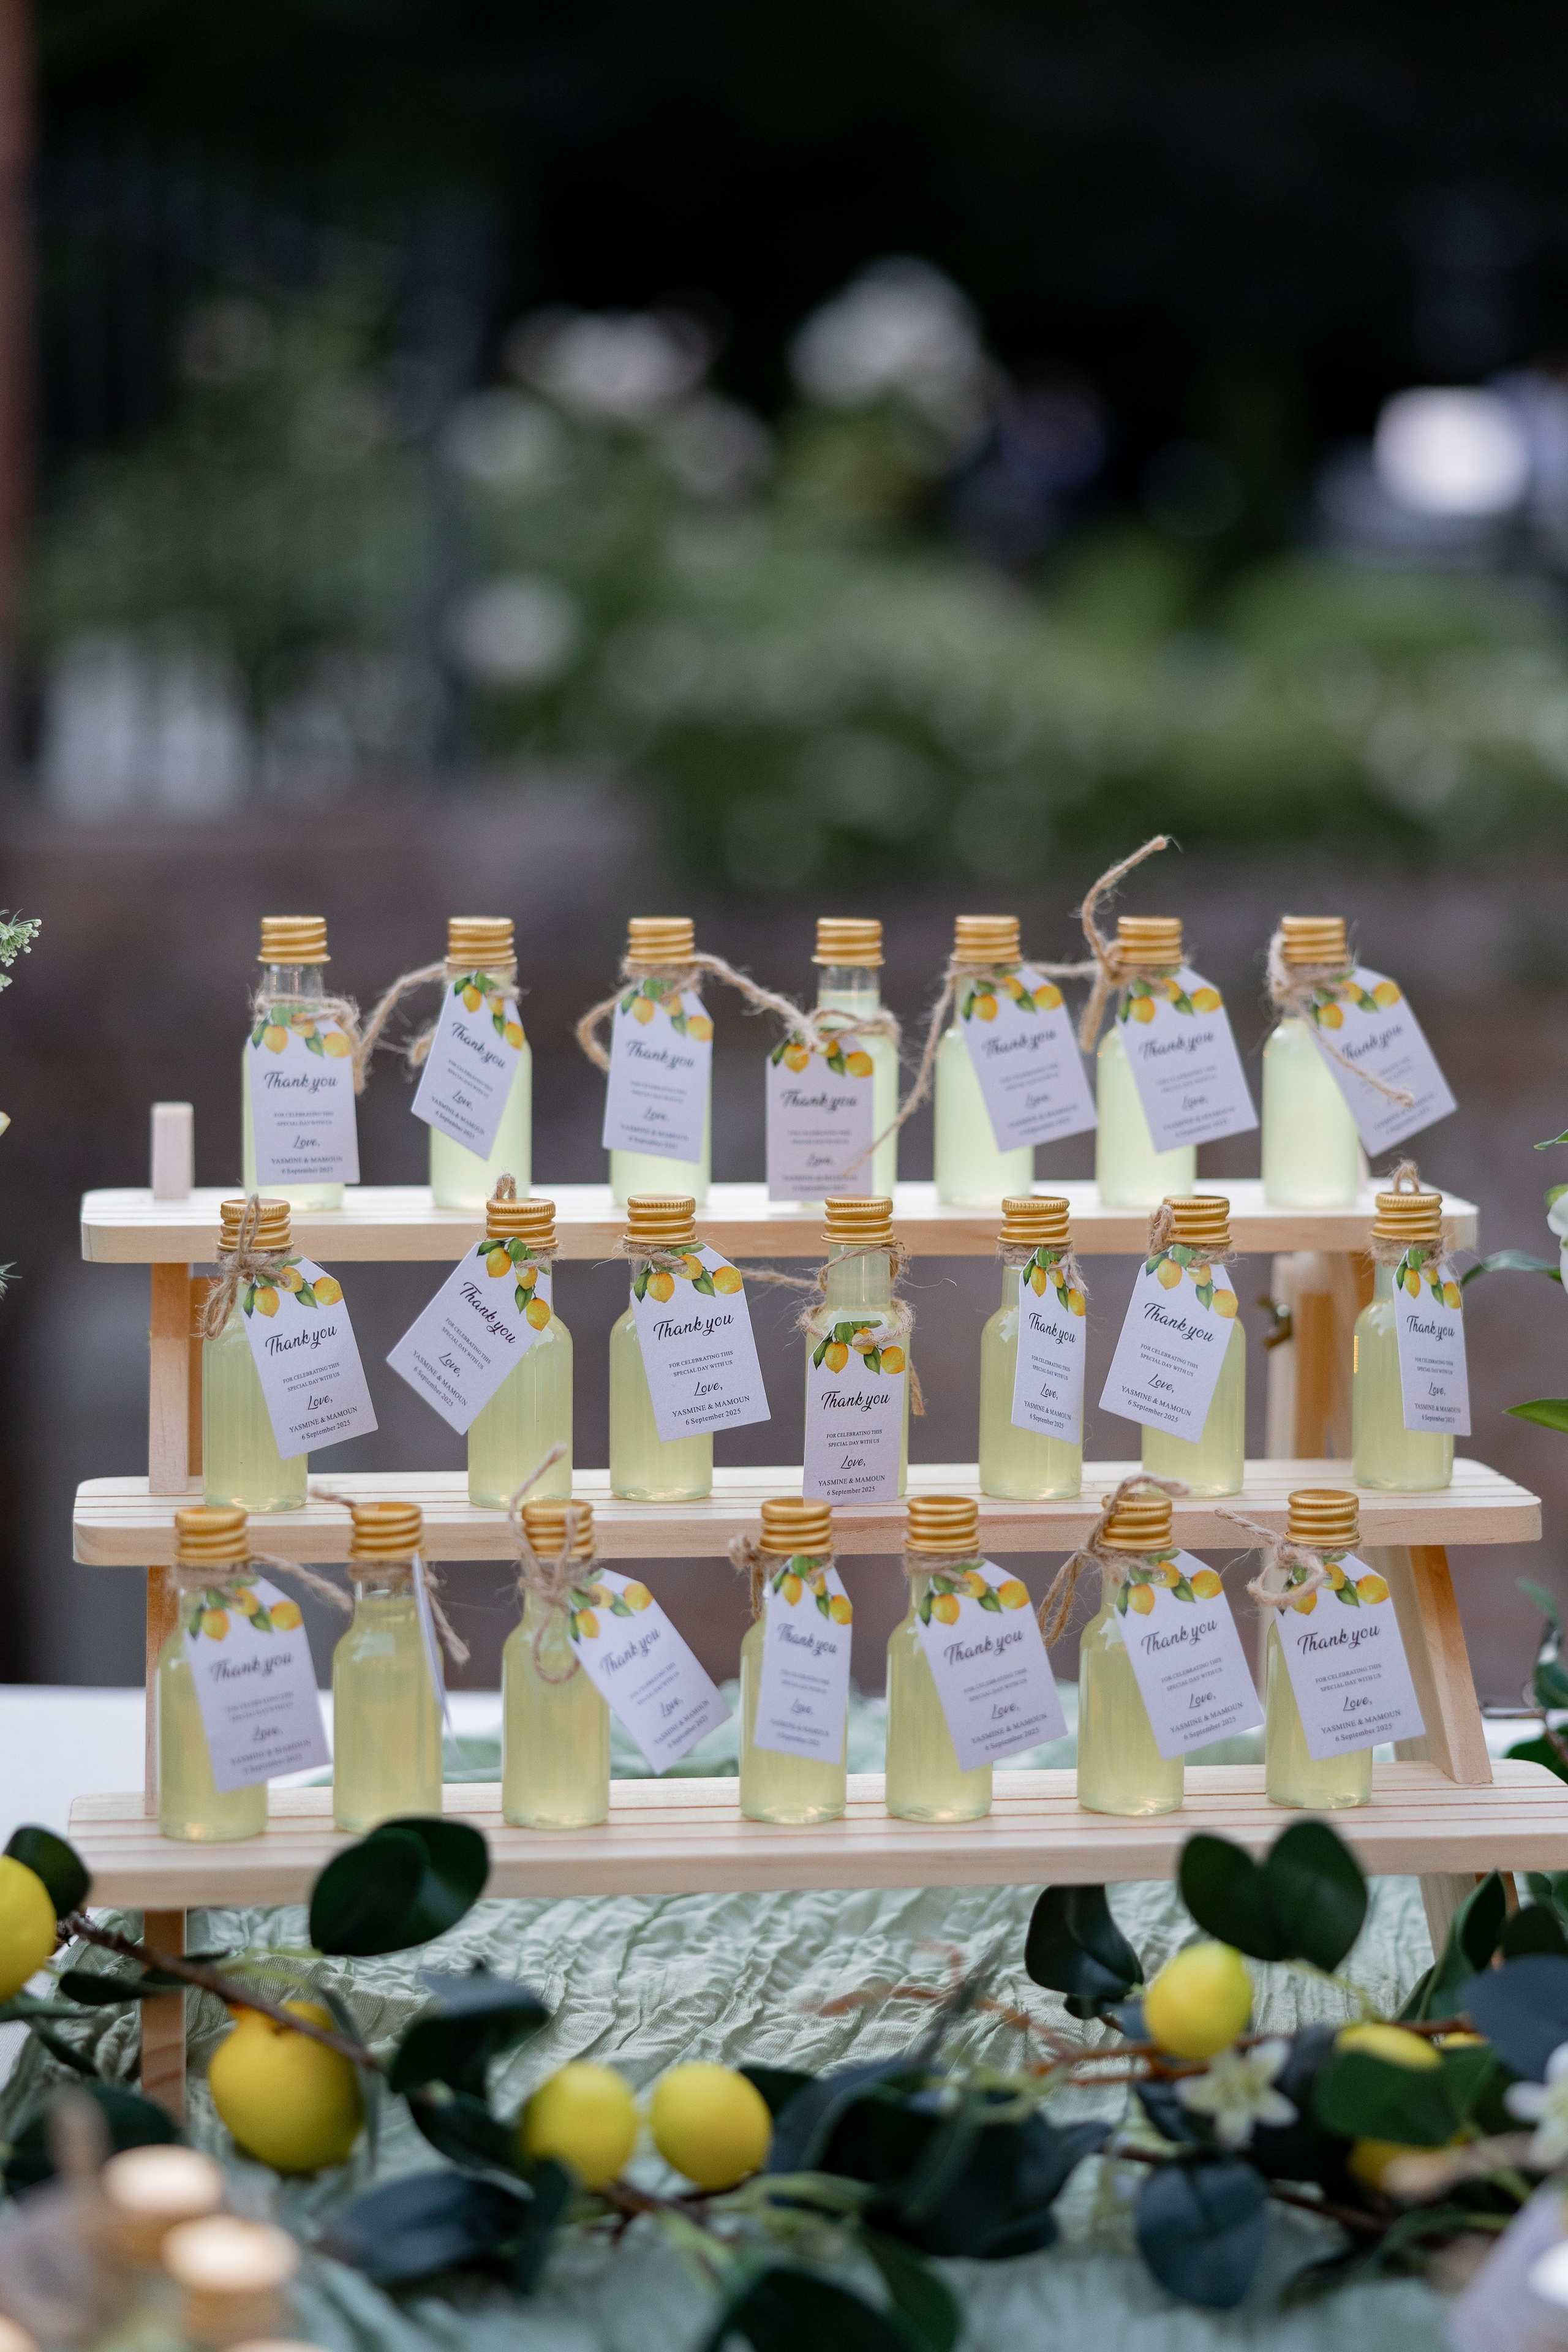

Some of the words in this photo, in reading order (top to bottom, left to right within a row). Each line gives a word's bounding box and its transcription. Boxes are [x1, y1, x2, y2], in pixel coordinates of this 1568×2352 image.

[451, 1021, 486, 1055] Thank
[480, 1050, 506, 1069] you
[625, 1039, 670, 1063] Thank
[665, 1054, 697, 1071] you
[263, 1071, 311, 1090] Thank
[307, 1077, 339, 1094] you
[459, 1281, 497, 1322] Thank
[486, 1321, 515, 1343] you
[1144, 1302, 1188, 1332] Thank
[1181, 1325, 1214, 1342] you
[652, 1315, 704, 1341] Thank
[701, 1314, 734, 1336] you
[1028, 1312, 1058, 1336] Thank
[1055, 1329, 1076, 1344] you
[1406, 1314, 1437, 1335] Thank
[1434, 1325, 1455, 1341] you
[265, 1329, 311, 1356] Thank
[309, 1325, 337, 1349] you
[441, 1326, 458, 1344] SPECIAL
[458, 1343, 468, 1353] DAY
[467, 1351, 478, 1364] WITH
[445, 1317, 454, 1328] FOR
[453, 1326, 481, 1355] CELEBRATING
[480, 1352, 491, 1364] THIS
[438, 1352, 461, 1378] Love,
[680, 1352, 720, 1365] CELEBRATING
[1038, 1357, 1061, 1369] CELEBRATING
[1140, 1343, 1151, 1351] FOR
[1151, 1348, 1186, 1364] CELEBRATING
[1186, 1360, 1198, 1369] THIS
[1140, 1352, 1160, 1364] SPECIAL
[1173, 1365, 1186, 1374] WITH
[293, 1365, 328, 1380] CELEBRATING
[412, 1349, 438, 1376] YASMINE
[440, 1378, 468, 1406] MAMOUN
[673, 1367, 695, 1377] SPECIAL
[1031, 1364, 1046, 1373] SPECIAL
[287, 1381, 307, 1392] SPECIAL
[417, 1369, 442, 1395] September
[440, 1393, 454, 1406] 2025
[693, 1381, 723, 1396] Love,
[1039, 1382, 1058, 1400] Love,
[1147, 1373, 1174, 1393] Love,
[307, 1395, 333, 1411] Love,
[671, 1404, 706, 1417] YASMINE
[714, 1395, 750, 1408] MAMOUN
[821, 1390, 864, 1410] Thank
[860, 1393, 891, 1412] you
[1024, 1400, 1045, 1412] YASMINE
[1049, 1408, 1071, 1420] MAMOUN
[1121, 1385, 1152, 1402] YASMINE
[1159, 1400, 1191, 1416] MAMOUN
[1132, 1401, 1163, 1417] September
[1163, 1412, 1178, 1422] 2025
[288, 1418, 320, 1433] YASMINE
[326, 1406, 357, 1421] MAMOUN
[690, 1412, 724, 1424] September
[725, 1408, 741, 1417] 2025
[1033, 1414, 1054, 1426] September
[1054, 1420, 1064, 1429] 2025
[306, 1425, 336, 1439] September
[336, 1419, 350, 1429] 2025
[840, 1455, 865, 1469] Love,
[818, 1477, 848, 1487] YASMINE
[854, 1474, 885, 1483] MAMOUN
[831, 1487, 861, 1496] September
[943, 1635, 995, 1666] Thank
[993, 1630, 1024, 1657] you
[1140, 1625, 1189, 1656] Thank
[1188, 1619, 1218, 1646] you
[1297, 1627, 1349, 1655] Thank
[1348, 1625, 1381, 1649] you
[598, 1640, 639, 1678] Thank
[637, 1628, 660, 1659] you
[1327, 1666, 1368, 1680] CELEBRATING
[1320, 1682, 1343, 1692] SPECIAL
[1188, 1692, 1216, 1709] Love,
[1342, 1696, 1372, 1712] Love,
[1170, 1716, 1203, 1733] YASMINE
[1209, 1701, 1243, 1719] MAMOUN
[1188, 1722, 1221, 1738] September
[1221, 1716, 1236, 1727] 2025
[1321, 1720, 1357, 1734] YASMINE
[1364, 1709, 1401, 1724] MAMOUN
[1340, 1728, 1375, 1741] September
[1376, 1722, 1392, 1732] 2025
